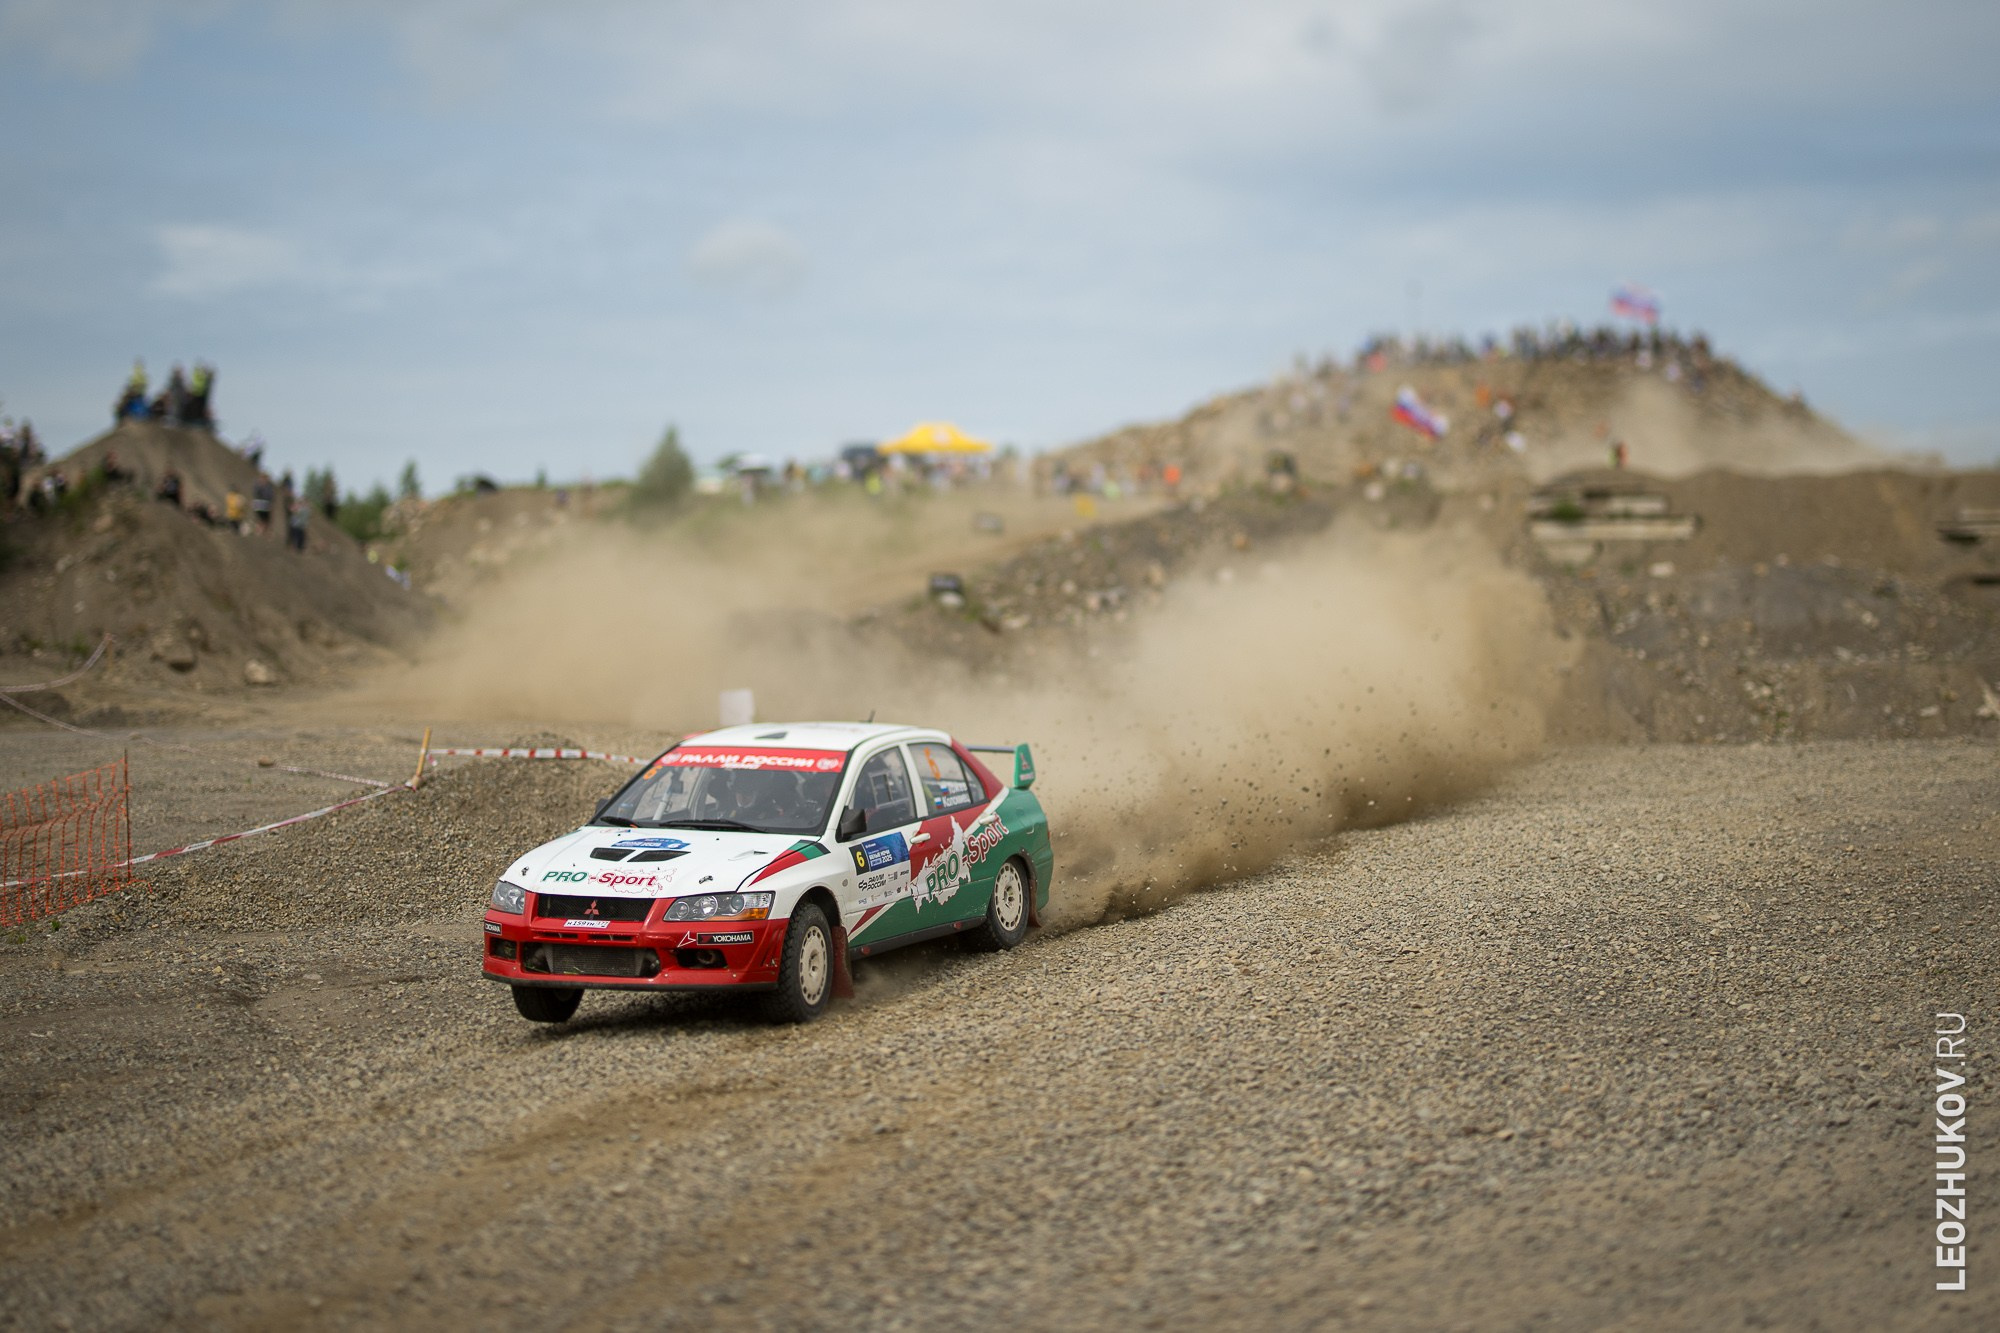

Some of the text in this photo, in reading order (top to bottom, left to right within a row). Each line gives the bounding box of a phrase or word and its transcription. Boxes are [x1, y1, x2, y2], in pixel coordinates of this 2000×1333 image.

[743, 755, 815, 767] РОССИИ
[856, 851, 865, 868] 6
[712, 934, 751, 943] YOKOHAMA
